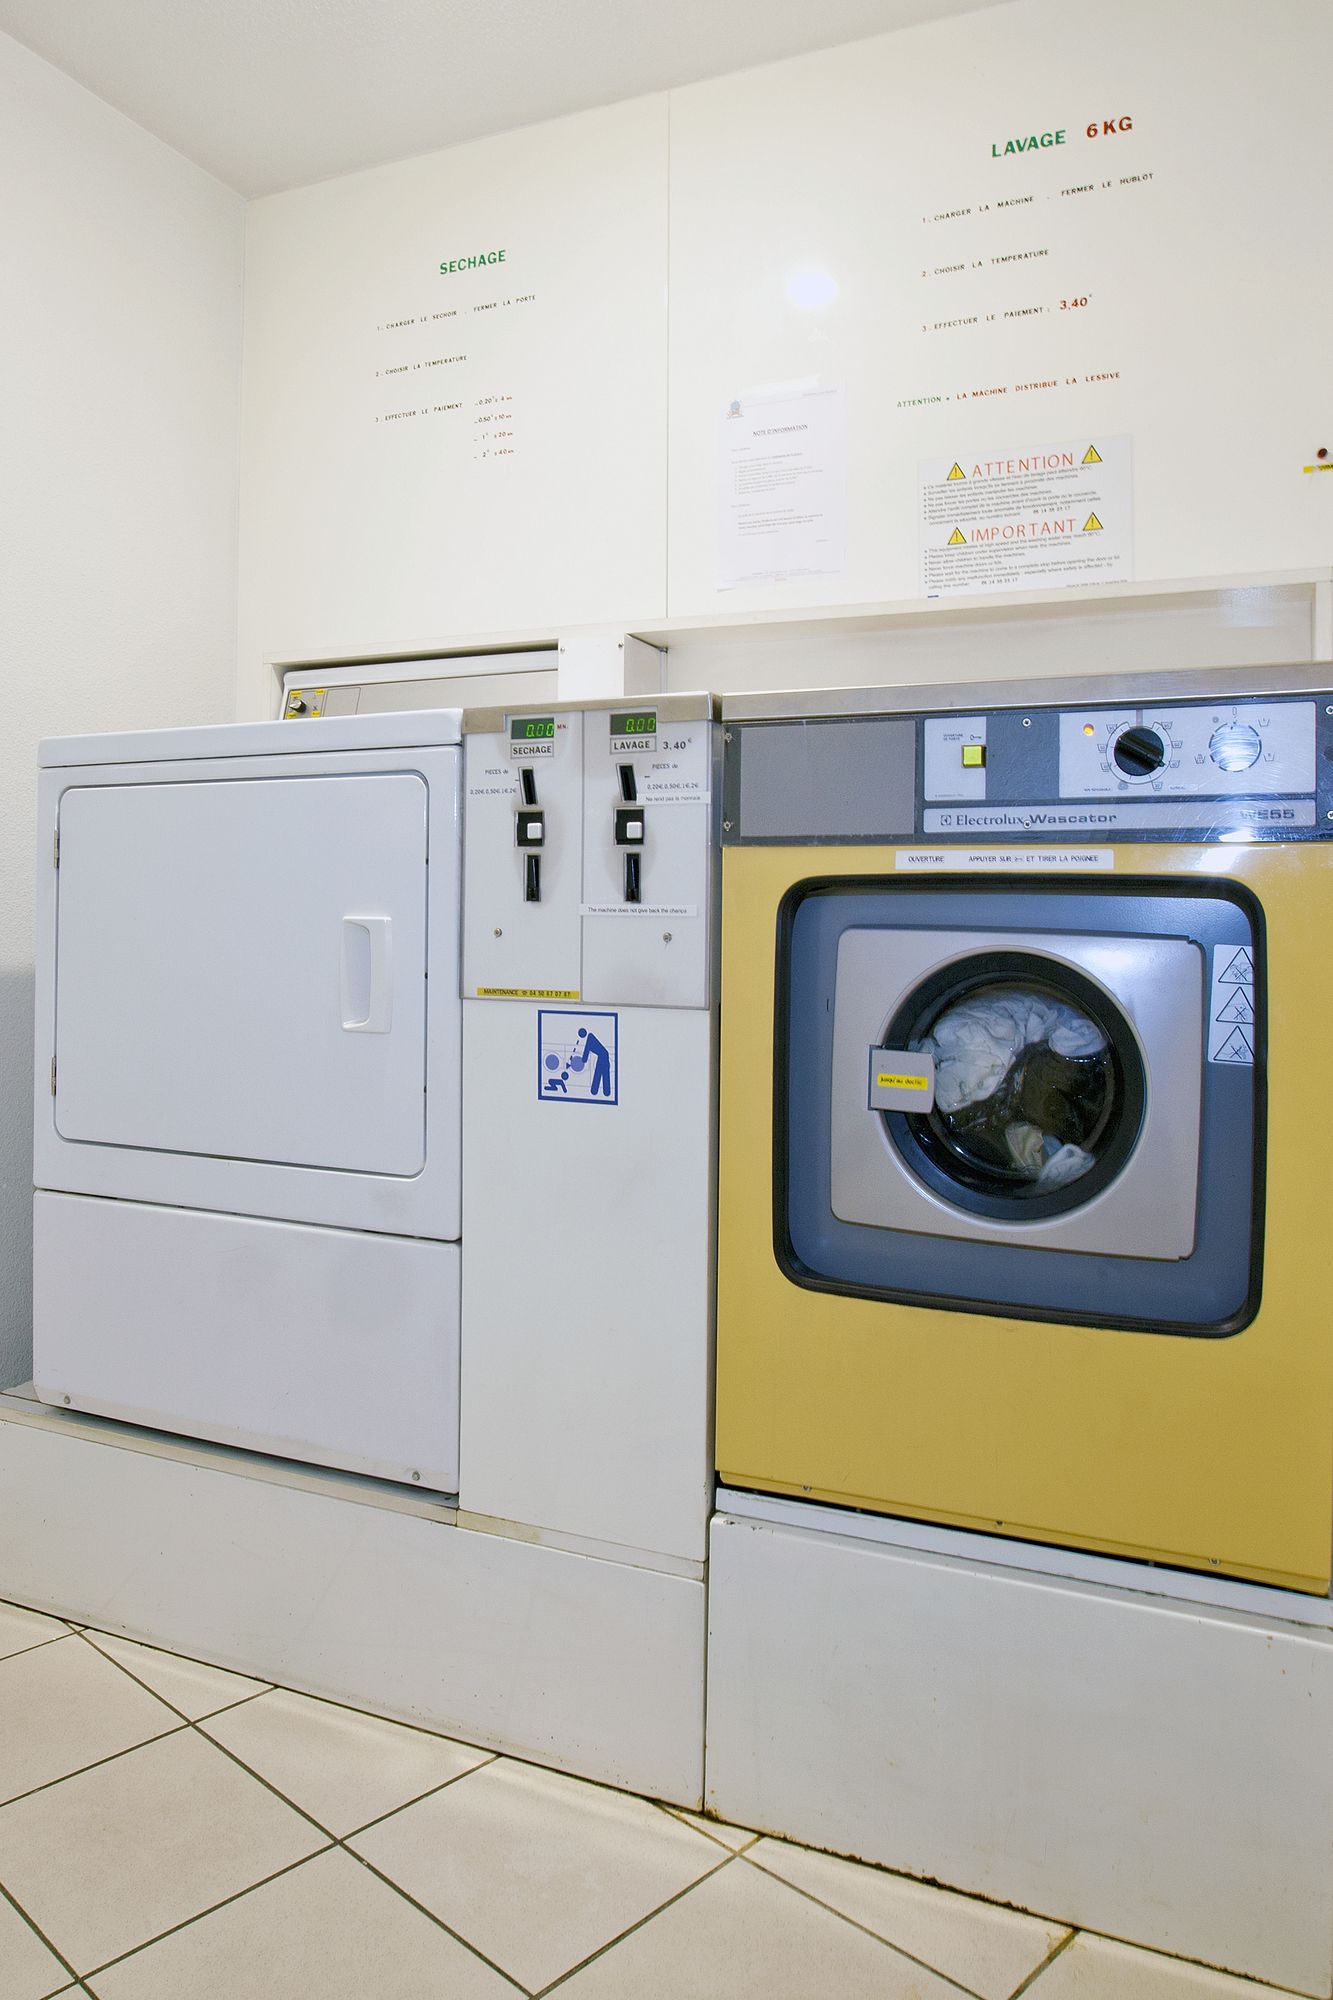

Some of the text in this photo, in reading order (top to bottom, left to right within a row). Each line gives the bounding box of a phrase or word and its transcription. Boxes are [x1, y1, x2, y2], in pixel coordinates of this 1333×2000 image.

[992, 116, 1132, 158] LAVAGE 6 KG
[934, 208, 972, 222] CHARGER
[997, 196, 1034, 208] MACHINE
[1060, 184, 1094, 197] FERMER
[1102, 180, 1112, 189] LE
[1120, 172, 1154, 186] HUBLOT
[440, 250, 506, 274] SECHAGE
[934, 264, 965, 275] CHOISIR
[972, 260, 983, 269] LA
[991, 249, 1049, 265] TEMPERATURE
[386, 318, 414, 329] CHARGER
[432, 310, 457, 320] SECHOIR
[474, 302, 497, 312] FERMER
[516, 295, 536, 304] PORTE
[934, 316, 978, 330] EFFECTUER
[986, 314, 996, 322] LE
[1004, 306, 1044, 319] PAIEMENT
[386, 366, 408, 374] CHOISIR
[424, 355, 468, 367] TEMPERATURE
[896, 372, 1121, 408] ATTENTION LA MACHINE DISTRIBUE LA LESSIVE
[385, 410, 416, 421] EFFECTUER
[434, 402, 462, 412] PAIEMENT
[972, 452, 1074, 478] ATTENTION
[971, 518, 1077, 543] IMPORTANT
[513, 745, 552, 755] SECHAGE
[614, 740, 650, 751] LAVAGE
[956, 812, 1118, 826] Electrolux Wascator
